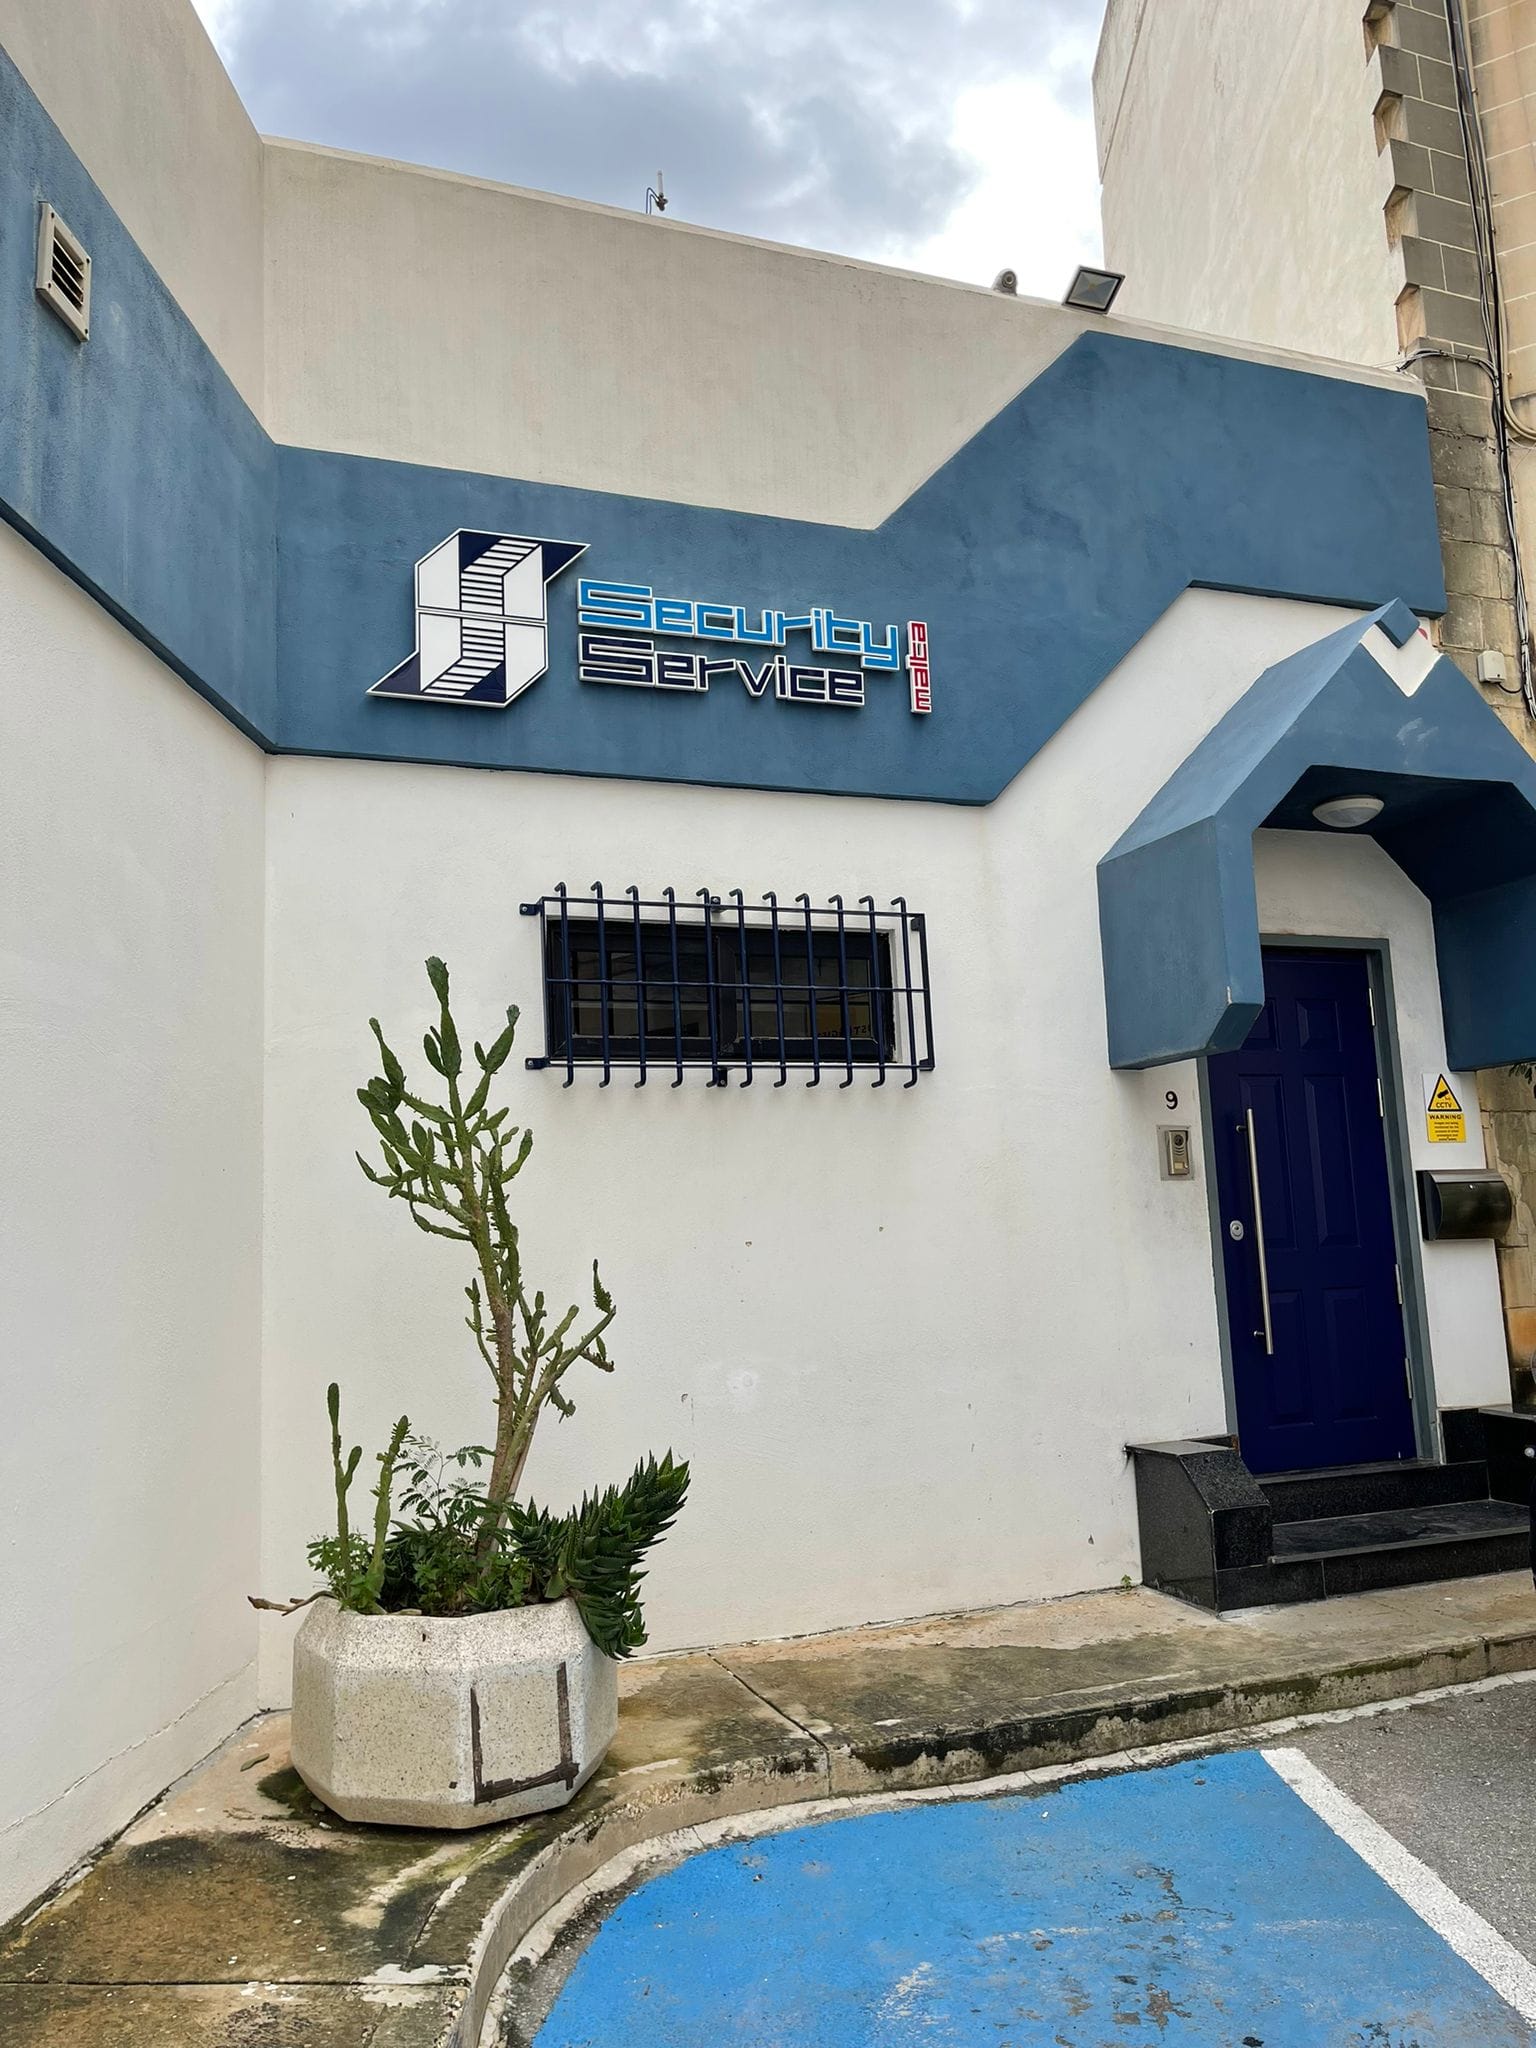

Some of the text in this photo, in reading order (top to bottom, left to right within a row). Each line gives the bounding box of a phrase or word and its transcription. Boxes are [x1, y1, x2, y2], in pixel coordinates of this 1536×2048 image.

[577, 577, 900, 672] Security
[577, 632, 865, 706] Service
[906, 621, 932, 713] malta
[1165, 1091, 1178, 1110] 9
